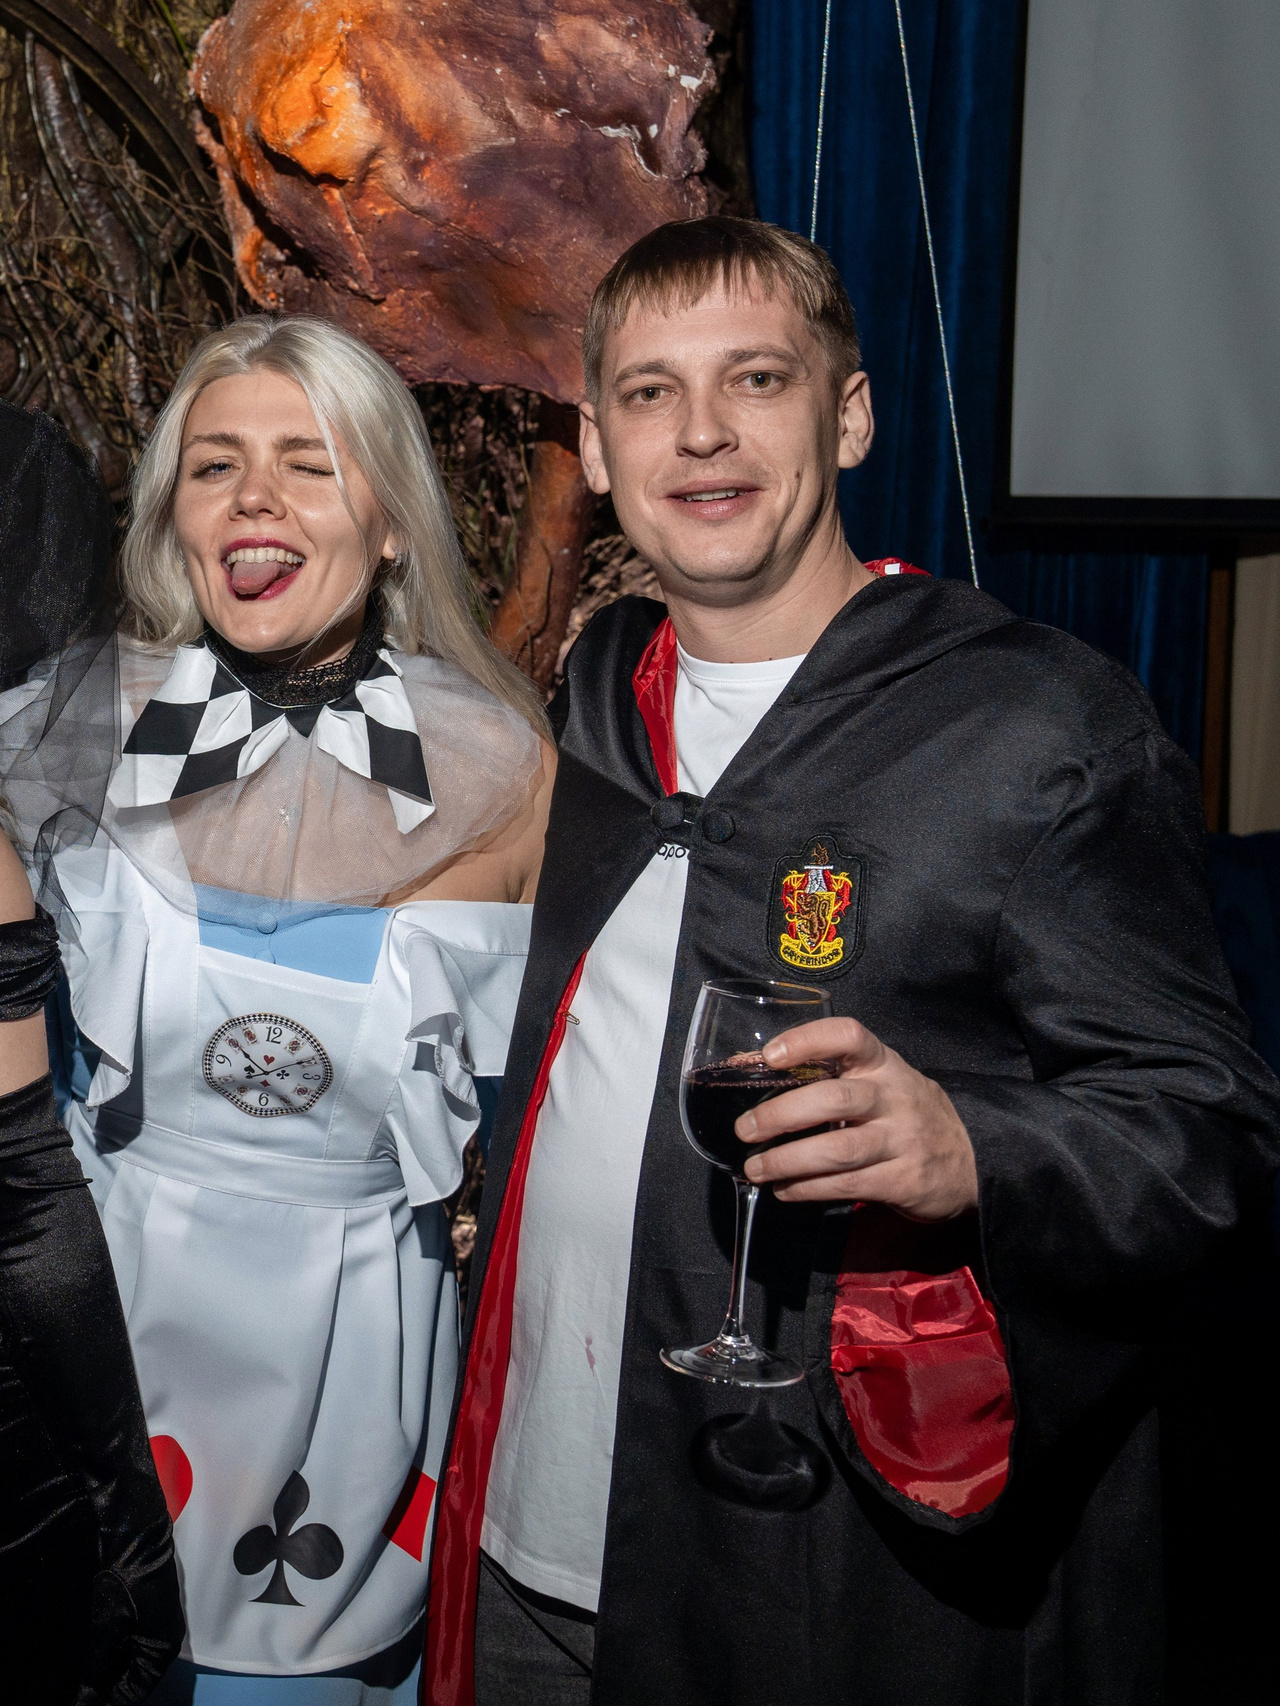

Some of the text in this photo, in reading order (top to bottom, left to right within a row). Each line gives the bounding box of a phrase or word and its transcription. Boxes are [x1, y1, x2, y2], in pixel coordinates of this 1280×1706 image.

[265, 1026, 283, 1045] 12
[302, 1073, 321, 1081] 3
[258, 1092, 269, 1107] 6
